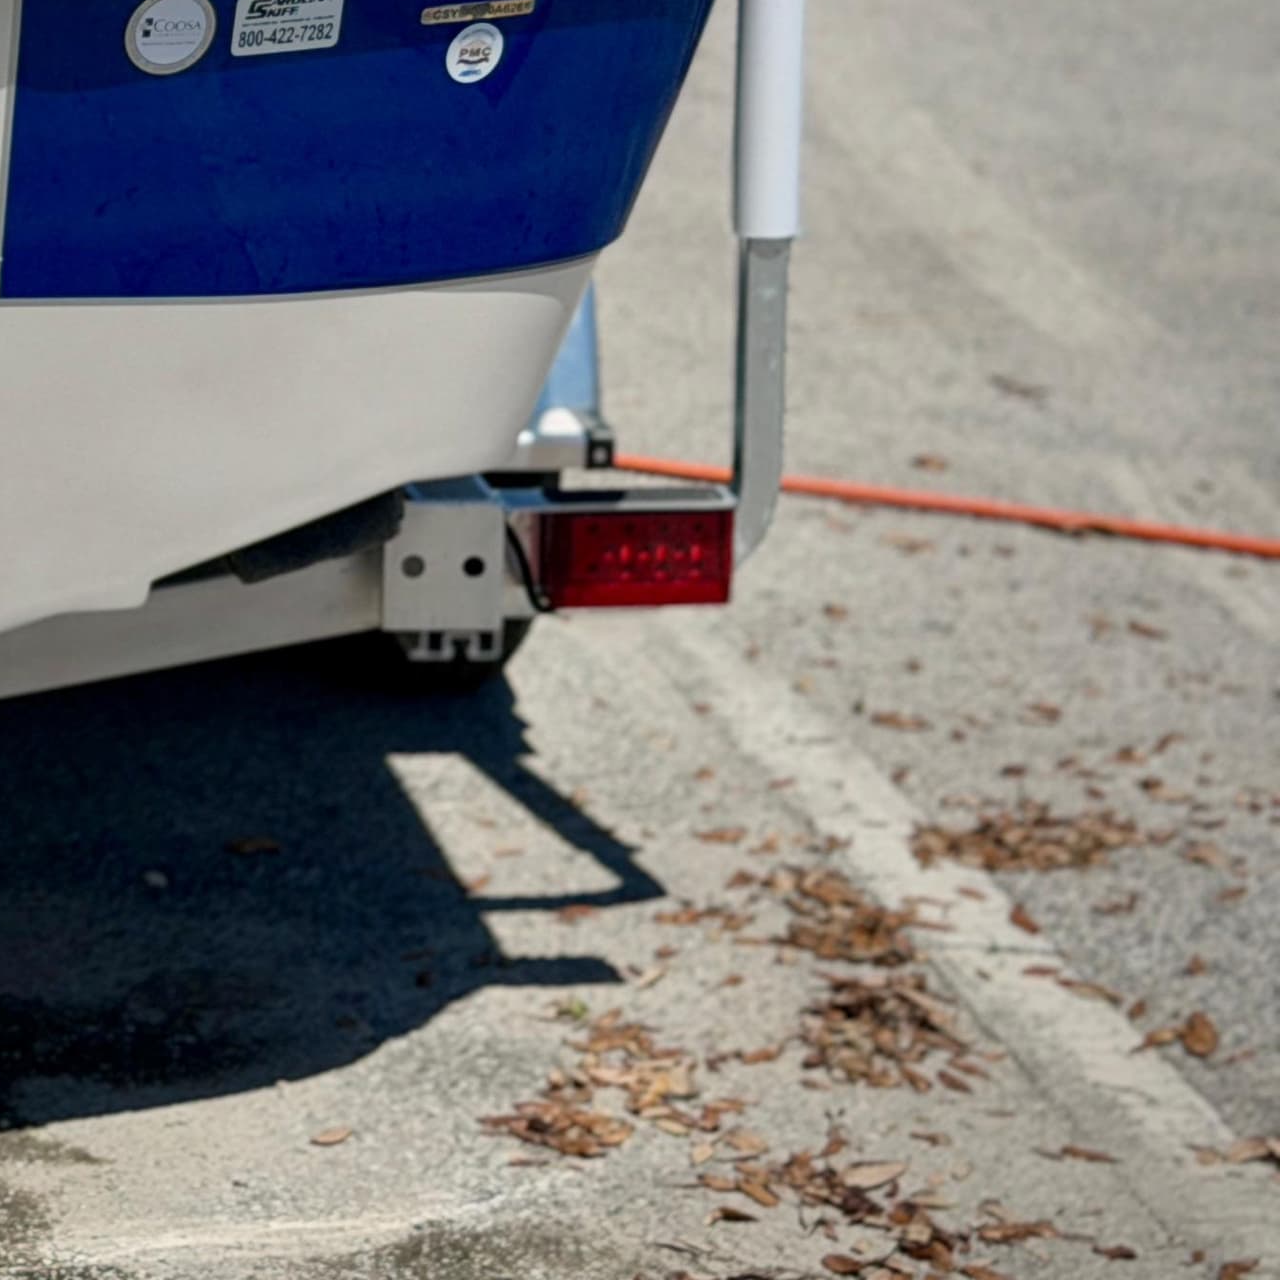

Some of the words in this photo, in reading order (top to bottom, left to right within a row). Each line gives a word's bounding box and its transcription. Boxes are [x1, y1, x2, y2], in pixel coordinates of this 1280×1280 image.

[245, 4, 299, 20] SKIFF
[154, 19, 200, 33] COOSA
[238, 23, 334, 48] 800-422-7282
[459, 46, 492, 58] PMC
